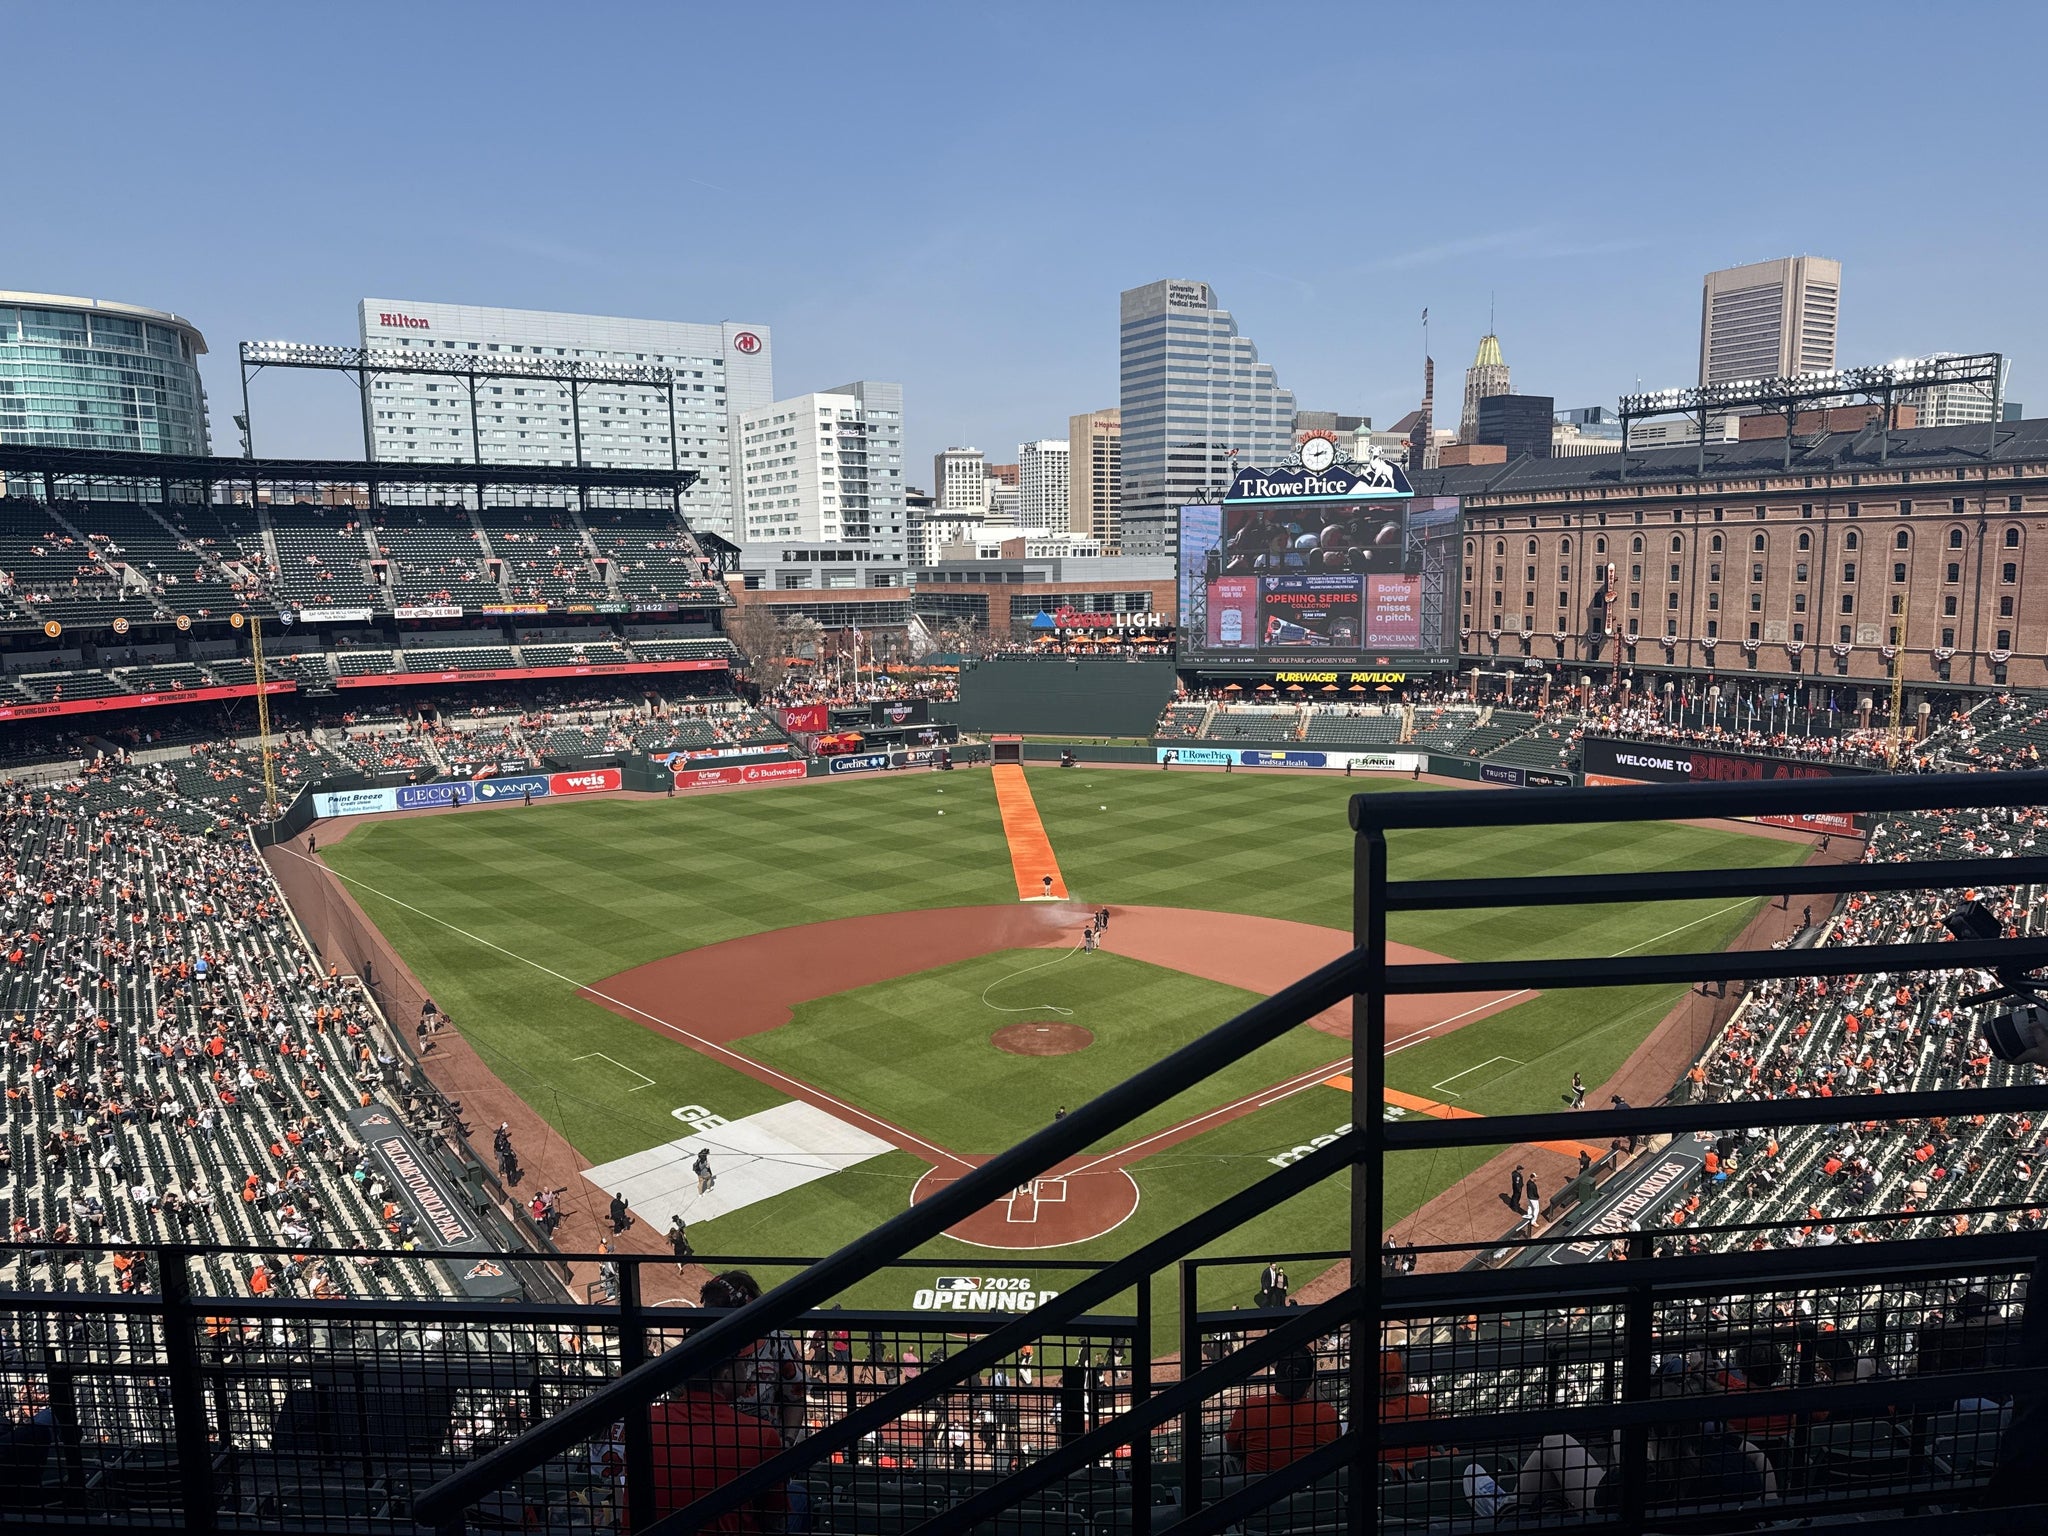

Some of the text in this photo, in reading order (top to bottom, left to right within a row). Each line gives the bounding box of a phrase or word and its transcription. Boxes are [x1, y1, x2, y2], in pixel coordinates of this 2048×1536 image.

[1169, 284, 1195, 294] University
[1176, 293, 1199, 301] Maryland
[1169, 299, 1207, 309] Medical System
[379, 313, 430, 329] Hilton
[1303, 476, 1347, 495] Price
[1378, 584, 1411, 594] Boring
[1265, 594, 1358, 603] OPENING SERIES
[1377, 603, 1411, 611] misses
[282, 614, 291, 622] 42
[1055, 605, 1111, 628] Coors
[1385, 613, 1414, 623] pitch.
[115, 622, 128, 630] 22
[179, 618, 189, 627] 33
[50, 624, 56, 634] 4
[1275, 672, 1405, 682] PUREWAGER PAVILION
[158, 694, 178, 702] OPENING
[14, 706, 38, 716] OPENING
[38, 706, 48, 714] DAY
[718, 748, 740, 756] BIRD
[741, 746, 764, 755] BATH
[916, 751, 933, 760] PNC
[836, 759, 869, 769] CareFirst
[1615, 753, 1674, 771] WELCOME
[1675, 760, 1693, 773] TO
[761, 768, 801, 778] Budweiser
[1486, 769, 1507, 778] TRUIST
[566, 773, 605, 787] weis
[496, 782, 543, 793] VANDA
[353, 793, 383, 801] Breeze
[403, 786, 466, 802] LECOM
[1815, 813, 1848, 823] CARROLL
[1634, 1161, 1686, 1198] ORIOLES
[381, 1139, 468, 1244] WELCOME TO ORIOLE PARK
[984, 1277, 1031, 1291] 2026
[912, 1289, 1037, 1310] OPENING
